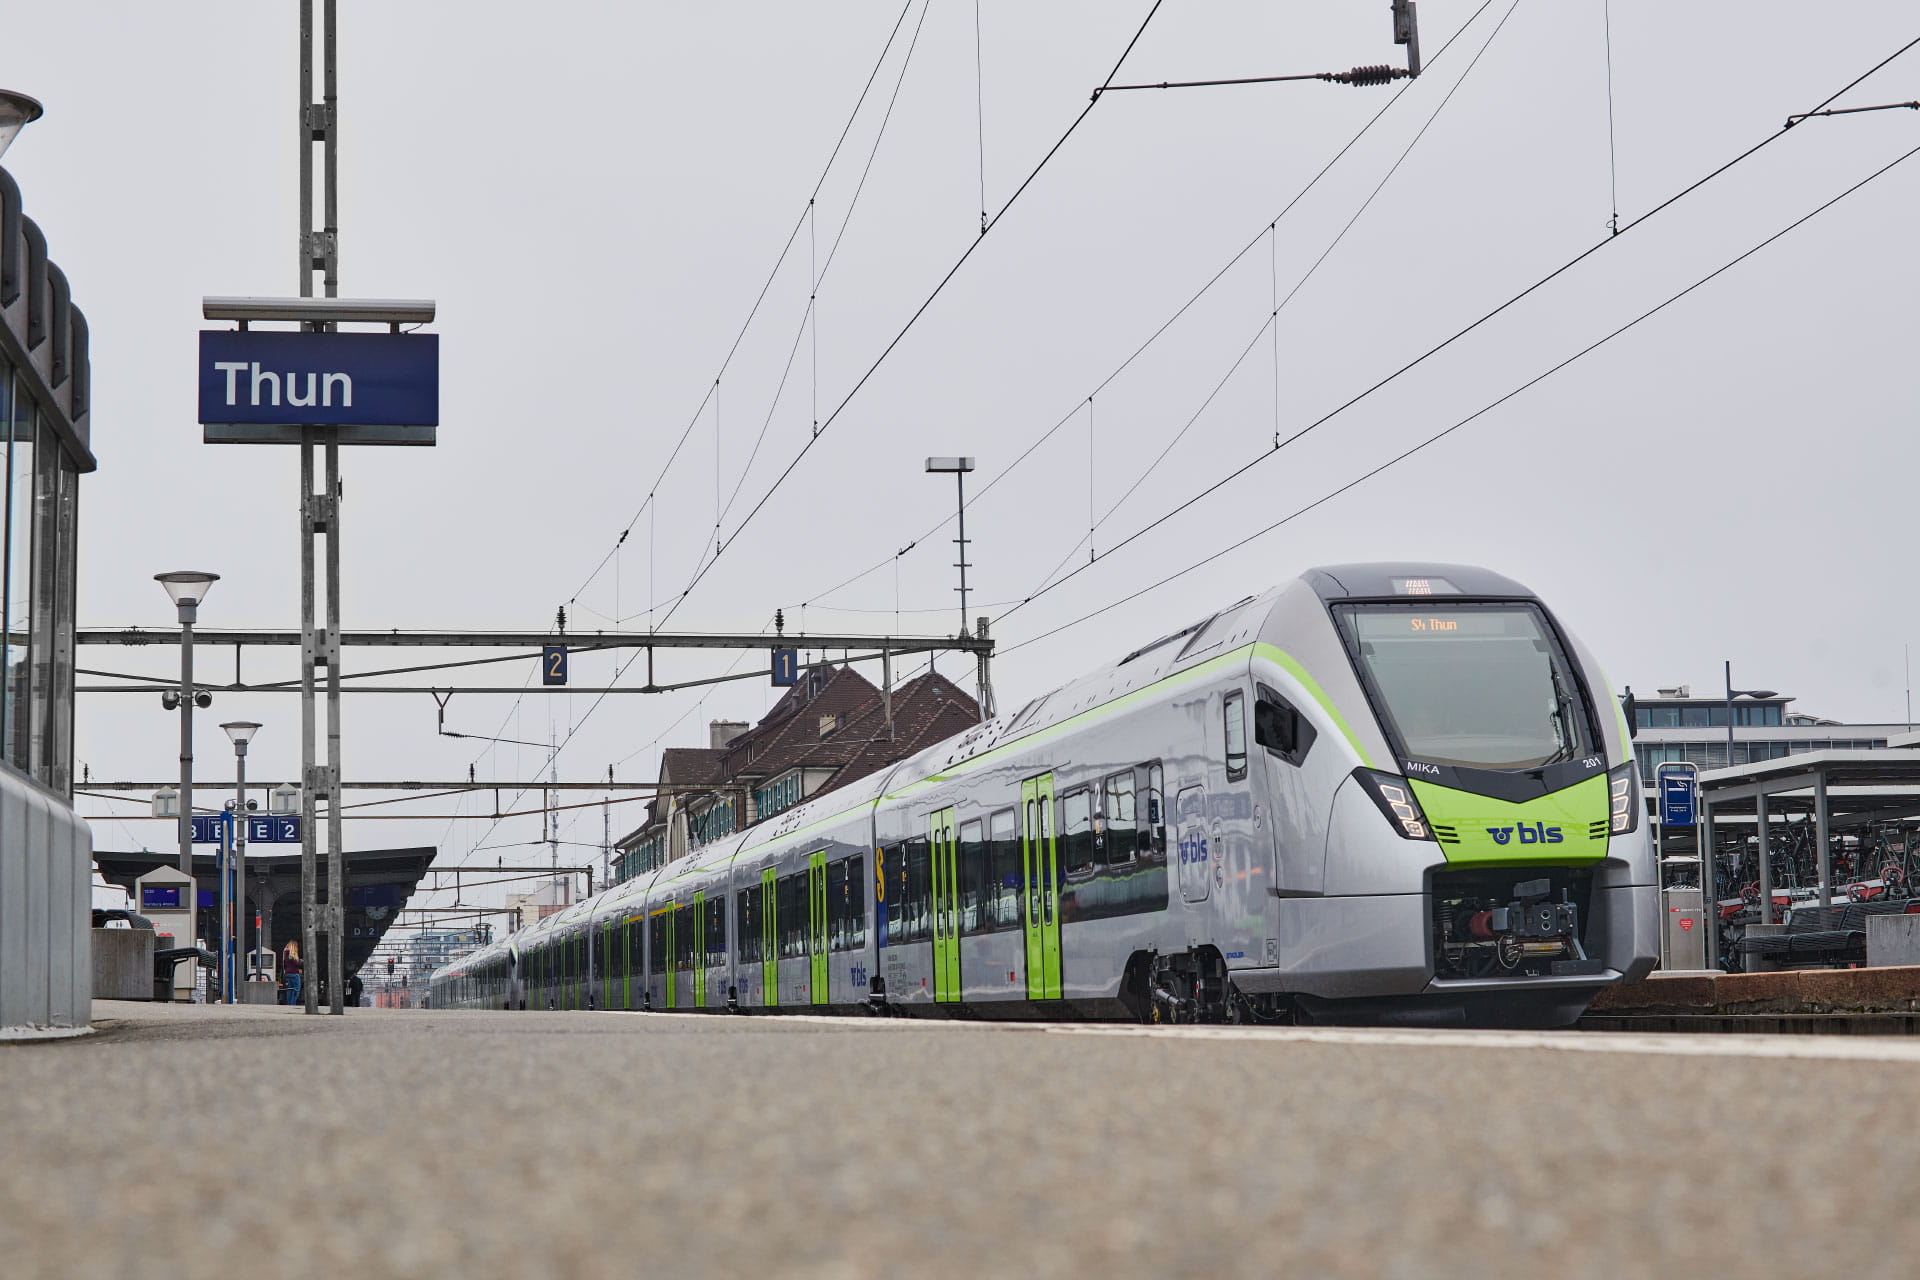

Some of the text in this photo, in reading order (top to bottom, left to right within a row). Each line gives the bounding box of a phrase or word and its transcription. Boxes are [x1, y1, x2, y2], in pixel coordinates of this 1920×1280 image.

[214, 361, 352, 407] Thun
[1411, 618, 1457, 631] S4 Thun
[549, 653, 562, 677] 2
[782, 654, 789, 678] 1
[1407, 761, 1440, 775] MIKA
[1583, 757, 1600, 769] 201
[1095, 783, 1101, 813] 2
[257, 824, 295, 838] E 2
[1517, 822, 1564, 844] bls
[901, 844, 906, 867] 2
[1189, 832, 1207, 863] bls
[353, 927, 375, 936] D 2
